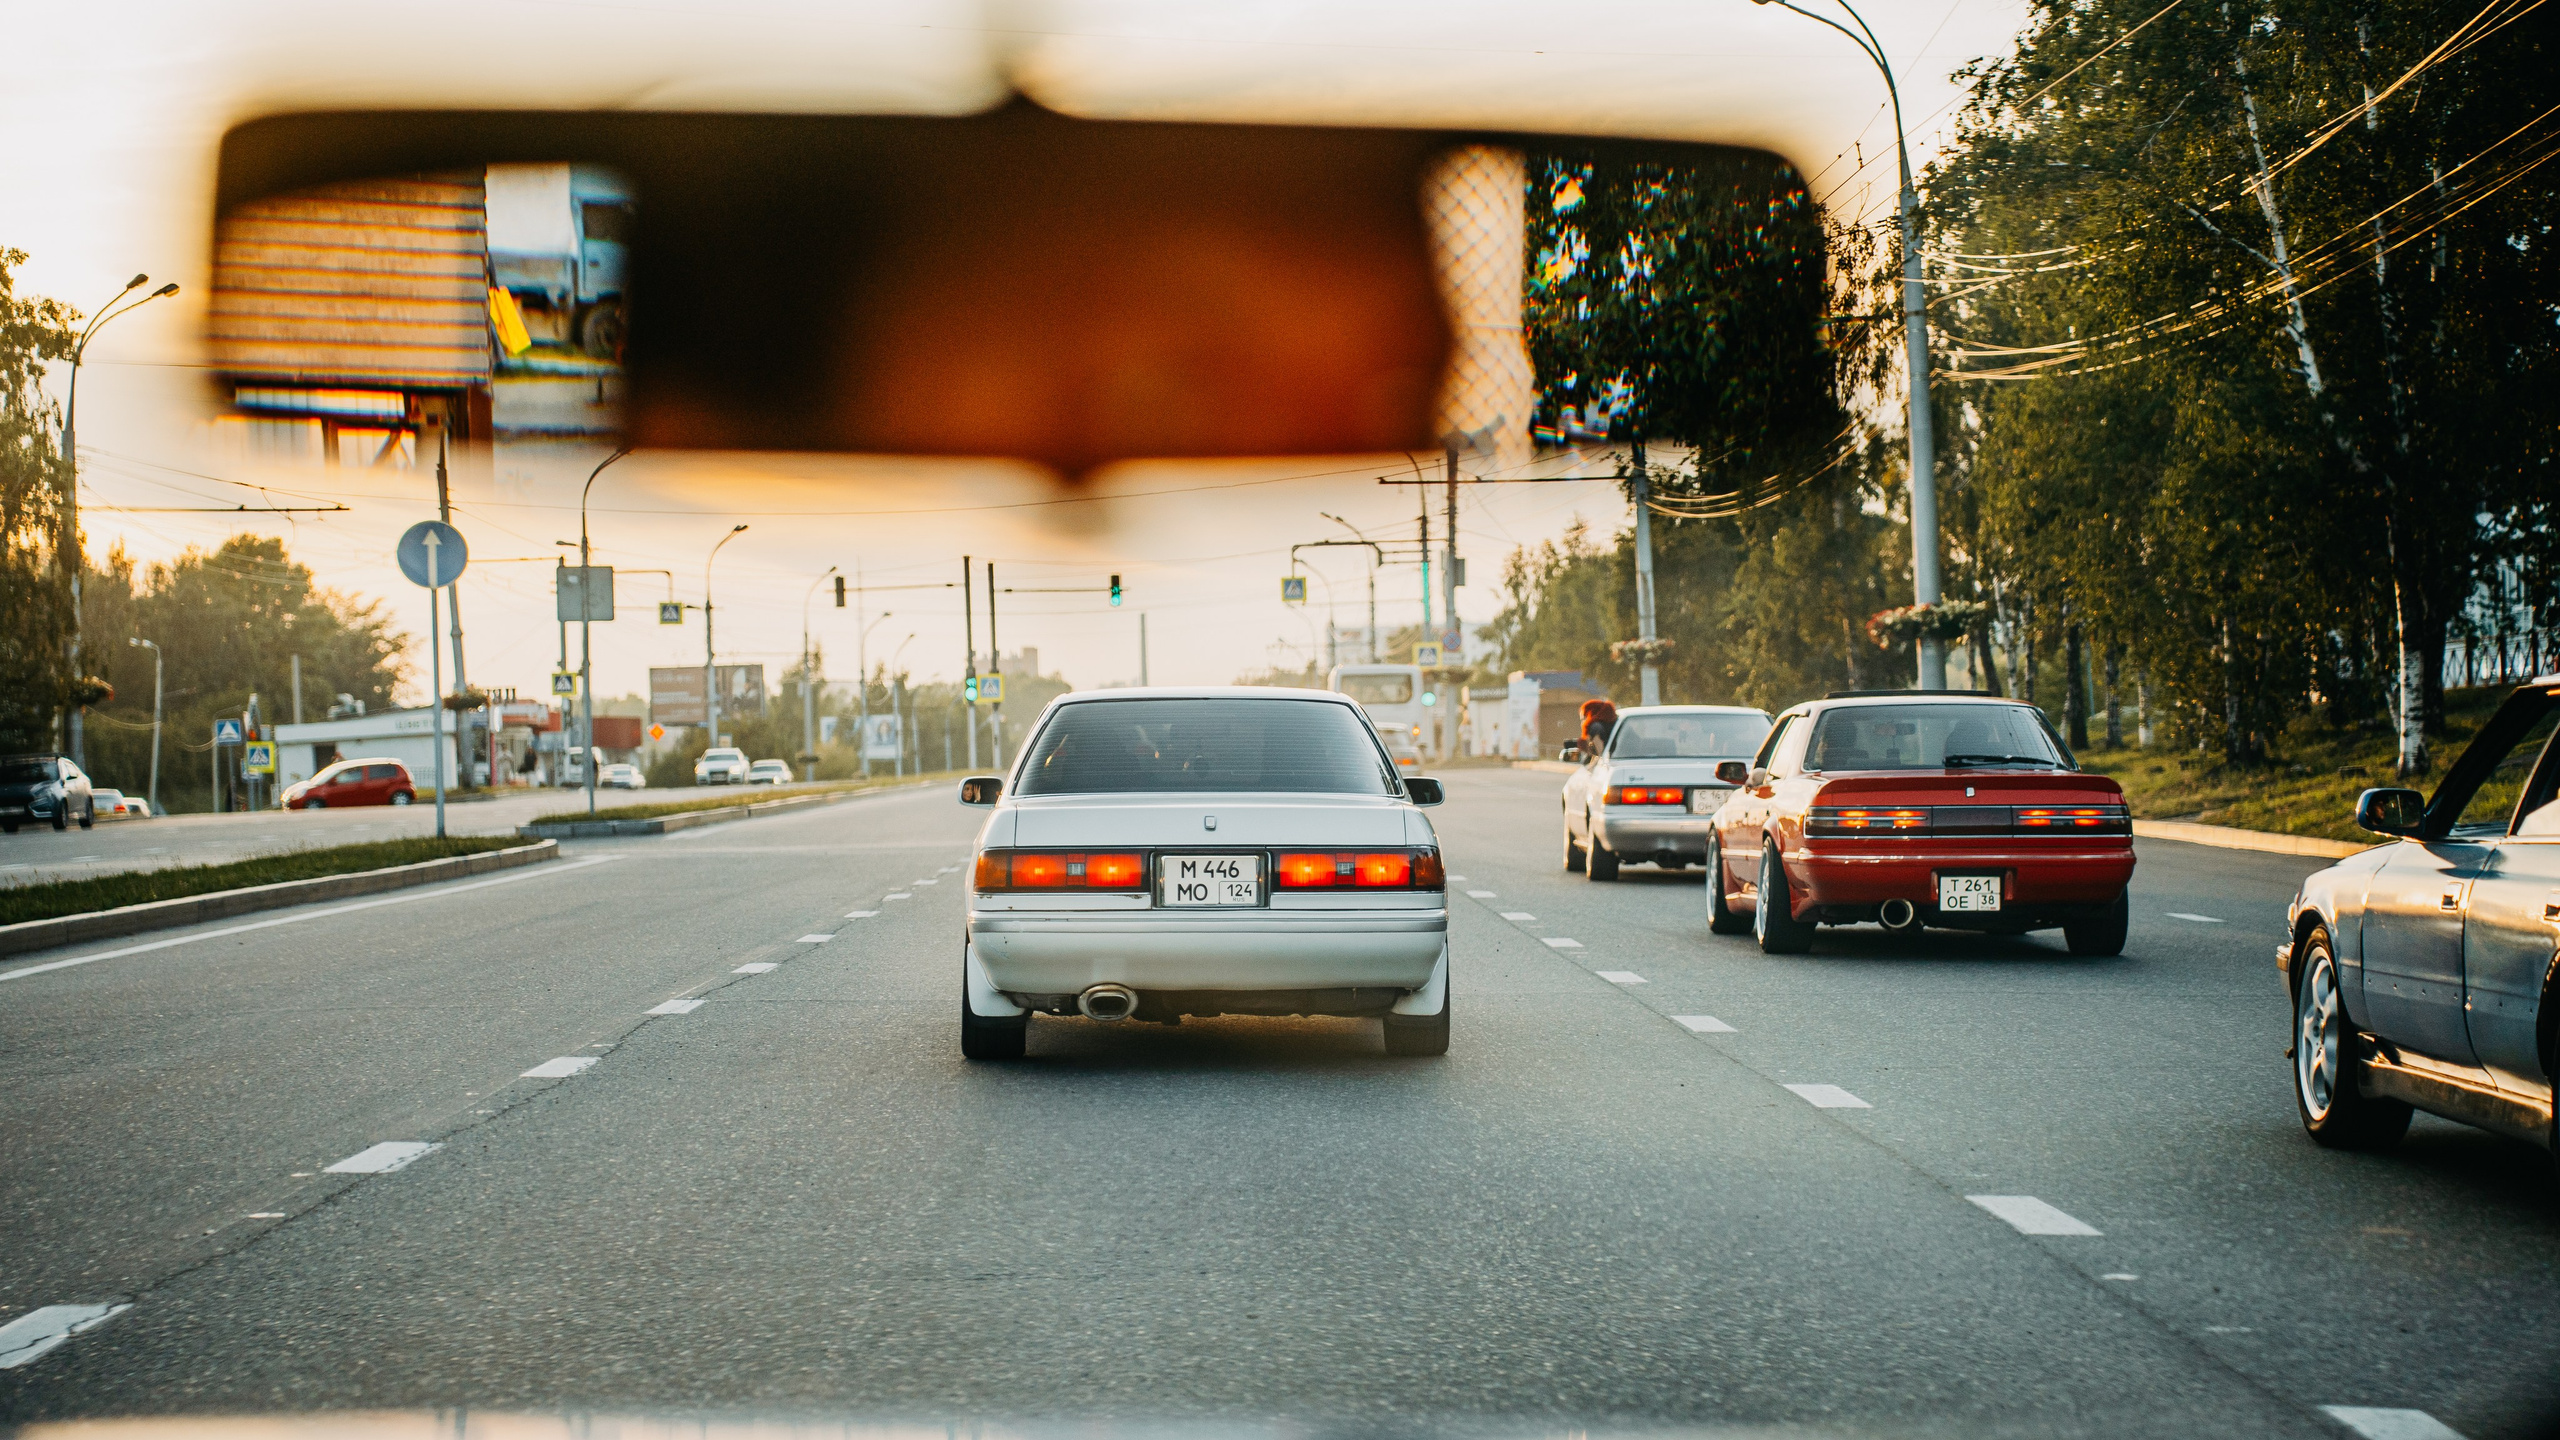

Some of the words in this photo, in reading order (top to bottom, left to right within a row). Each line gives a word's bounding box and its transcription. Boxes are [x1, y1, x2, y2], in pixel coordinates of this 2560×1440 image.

[1181, 861, 1196, 878] М
[1203, 861, 1239, 878] 446
[1178, 884, 1208, 901] МО
[1227, 884, 1252, 897] 124
[1951, 879, 1959, 891] Т
[1965, 879, 1991, 891] 261
[1947, 896, 1968, 908] ОЕ
[1981, 894, 1995, 905] 38
